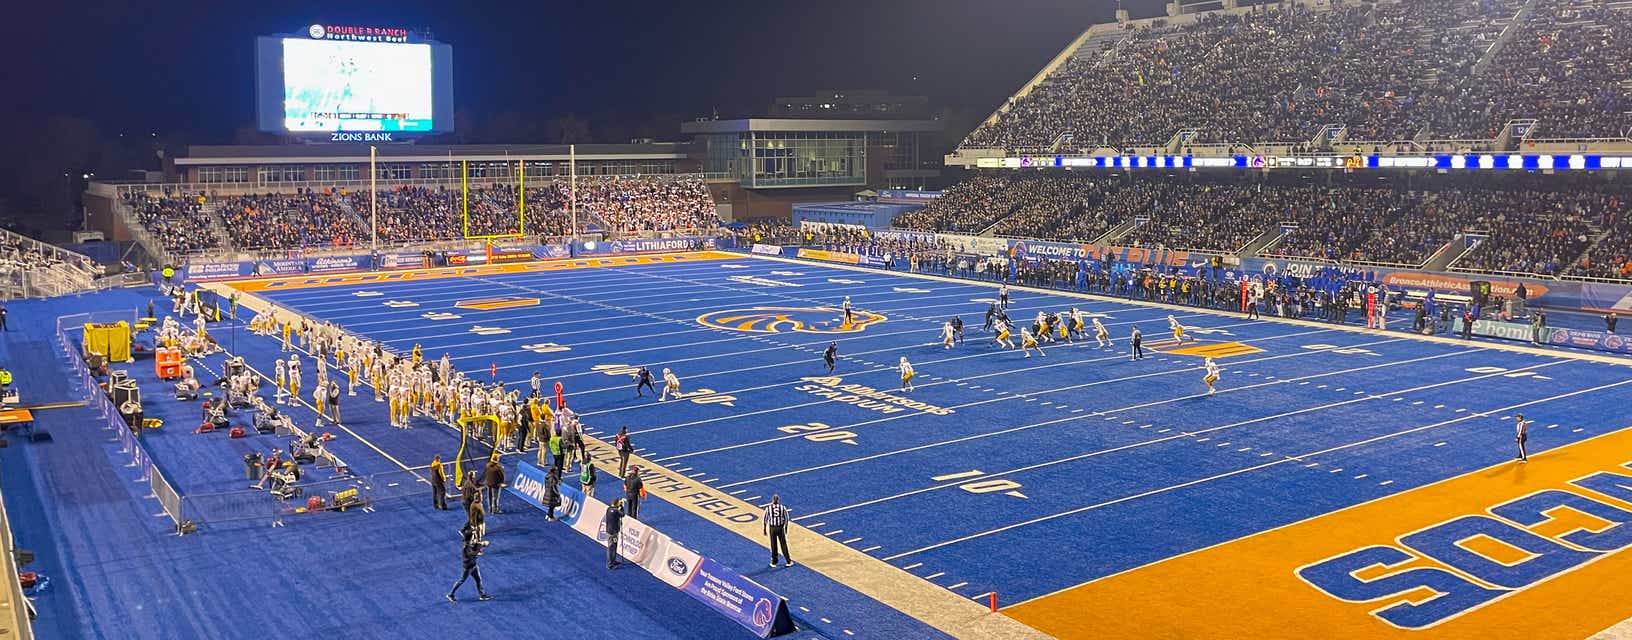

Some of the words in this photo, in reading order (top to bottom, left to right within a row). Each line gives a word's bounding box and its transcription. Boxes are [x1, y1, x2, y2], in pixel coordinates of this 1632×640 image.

[327, 26, 364, 35] DOUBLE
[375, 28, 407, 36] RANCH
[326, 33, 383, 42] Northwest
[385, 35, 407, 43] Beef
[331, 133, 362, 141] ZIONS
[364, 133, 392, 141] BANK
[1028, 244, 1072, 257] WELCOME
[1074, 248, 1086, 257] TO
[794, 384, 905, 414] STADIUM
[776, 422, 858, 442] 20
[931, 469, 1024, 494] 10
[680, 491, 758, 523] FIELD
[773, 507, 780, 517] S
